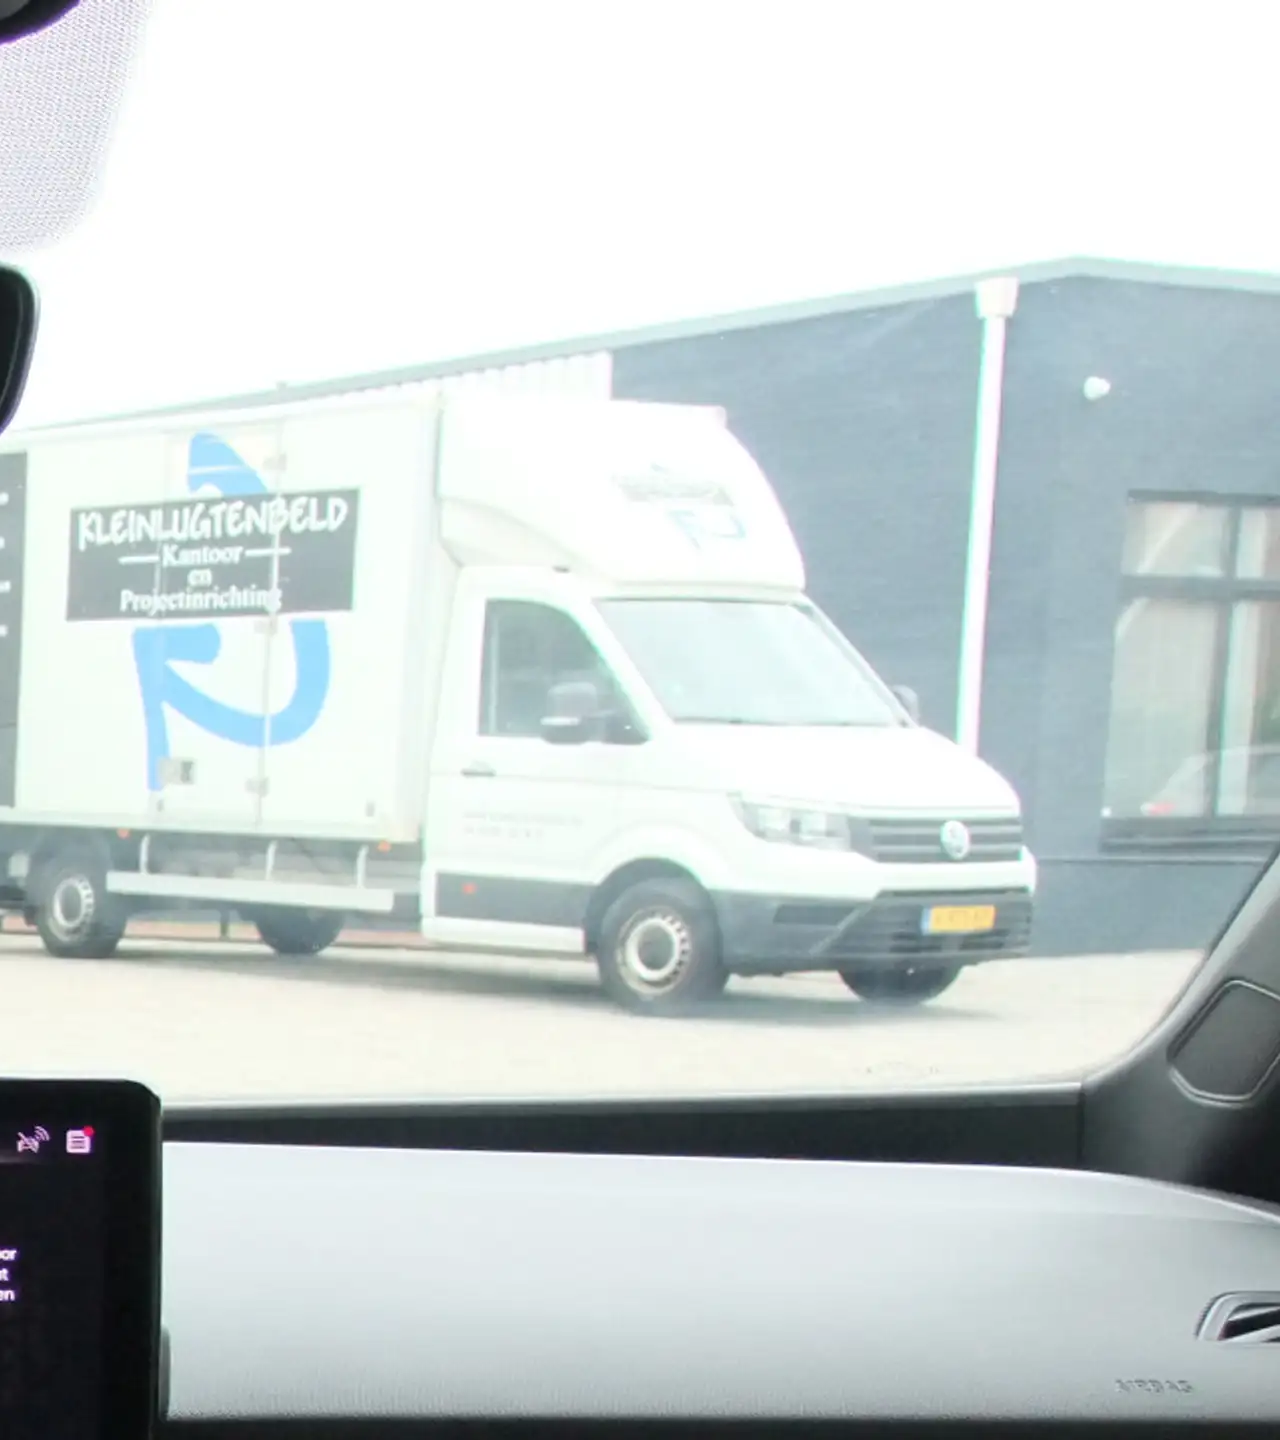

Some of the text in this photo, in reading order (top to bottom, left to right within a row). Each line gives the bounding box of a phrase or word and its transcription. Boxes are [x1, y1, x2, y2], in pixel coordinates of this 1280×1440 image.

[77, 496, 349, 551] KLEINLUGTENBELD
[161, 544, 244, 568] Kantoor
[188, 568, 212, 586] en
[119, 585, 283, 617] Projectinrichting
